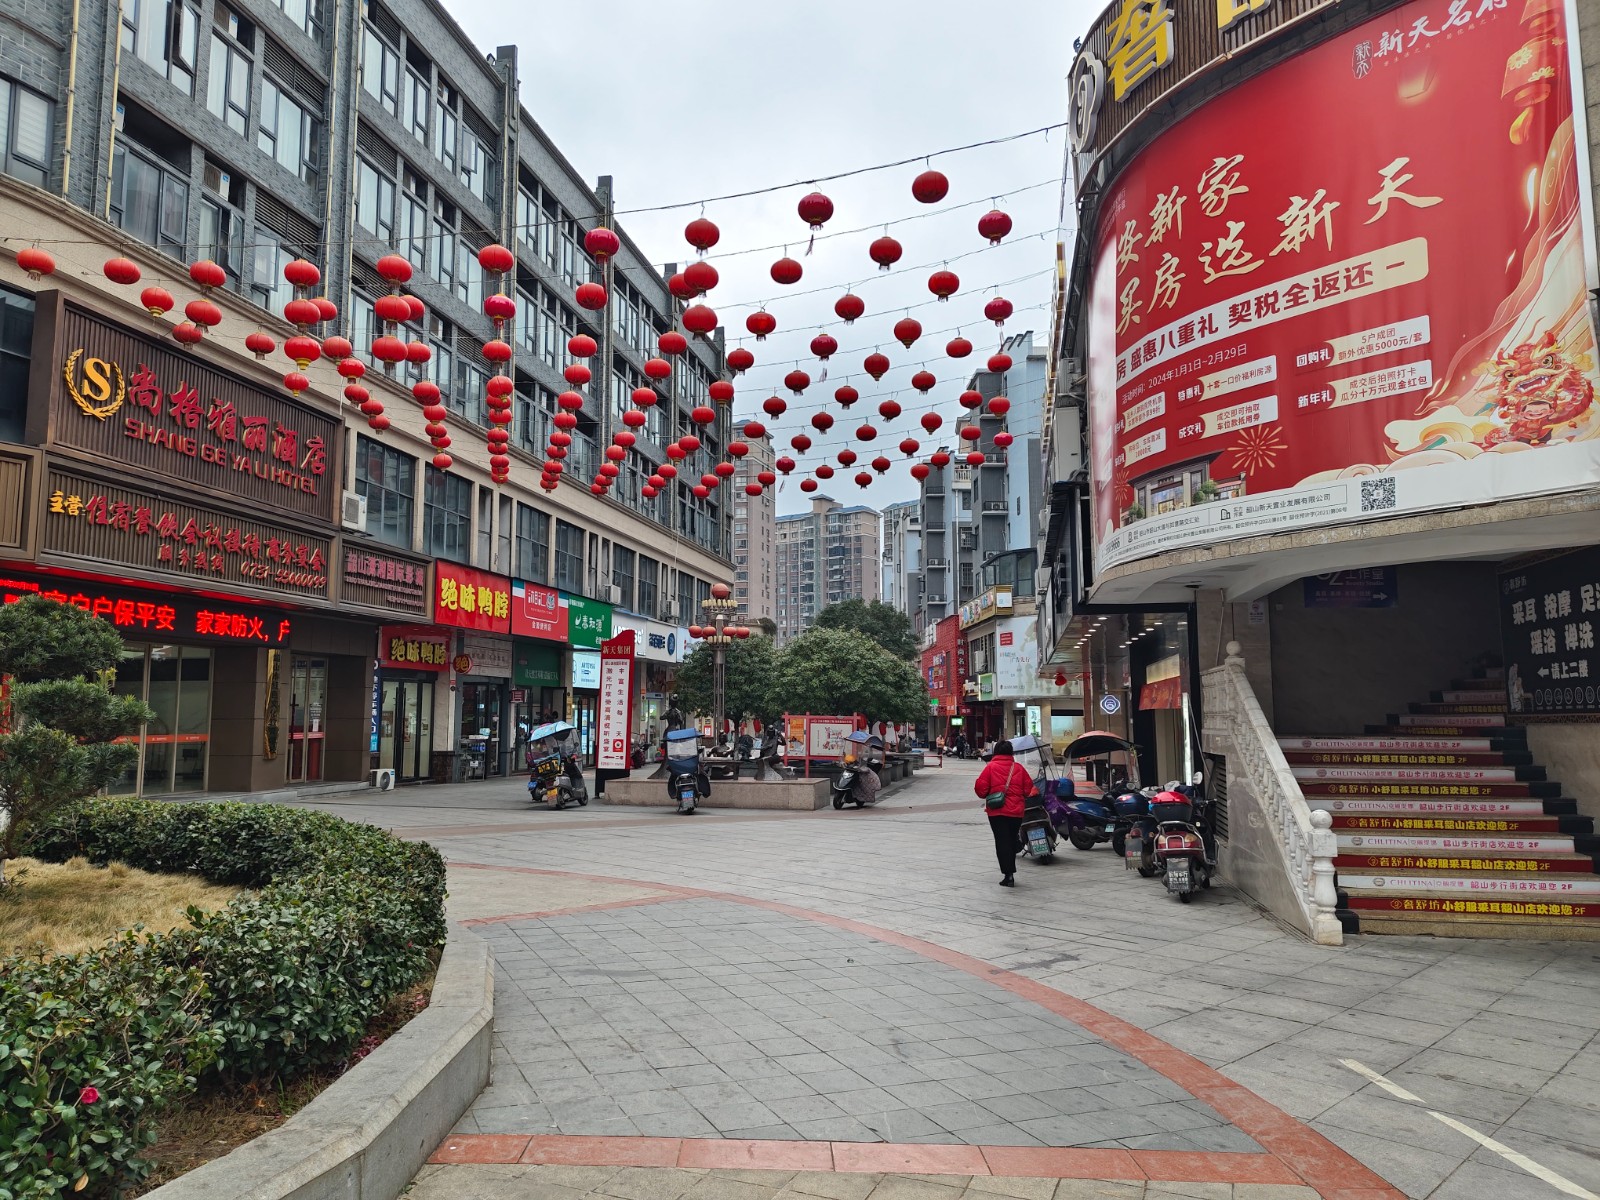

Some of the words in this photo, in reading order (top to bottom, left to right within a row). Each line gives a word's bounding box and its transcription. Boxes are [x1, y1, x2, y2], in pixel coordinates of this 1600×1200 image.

[1131, 313, 1218, 372] 盛惠八重礼
[1362, 328, 1396, 343] 5户成团
[1338, 332, 1423, 360] 额外优惠5000元/套
[1296, 348, 1331, 367] 团购礼
[82, 357, 112, 401] S
[1207, 365, 1272, 391] 十套一口价福利房源
[1349, 367, 1417, 389] 成交后拍照打卡
[1341, 376, 1427, 402] 瓜分十万元现金红包
[1297, 390, 1332, 408] 新年礼
[128, 362, 327, 475] 尚格雅丽酒店
[1216, 403, 1260, 422] 成交即可抽取
[1179, 422, 1203, 439] 成交礼
[1217, 415, 1260, 431] 车位款抵用券
[125, 417, 198, 457] SHANG
[201, 443, 226, 468] GE
[230, 452, 252, 475] YA
[254, 460, 268, 480] LI
[271, 465, 318, 495] HOTEL
[440, 577, 509, 619] 绝味鸭脖
[1512, 598, 1537, 625] 采耳
[1544, 590, 1572, 620] 按摩
[391, 638, 447, 664] 绝味鸭脖
[603, 645, 631, 655] 新天集团
[455, 656, 471, 673] 绝
[1551, 659, 1589, 680] 请上二楼
[616, 668, 625, 737] 丰富生活每一天
[1371, 785, 1479, 795] 小舒服采耳韶山店欢迎您
[1419, 803, 1497, 812] 韶山步行街店欢迎您
[1359, 818, 1391, 828] 奢舒坊
[1393, 818, 1508, 831] 小舒服采耳韶山店欢迎您
[1509, 823, 1520, 831] 2F
[1443, 840, 1524, 849] 韶山步行街店欢迎您
[1379, 856, 1414, 867] 奢舒坊
[1416, 858, 1538, 871] 小舒服采耳韶山店欢迎您
[1539, 862, 1551, 871] 2F
[1470, 880, 1557, 891] 韶山步行街店欢迎您
[1403, 900, 1440, 910] 奢舒坊
[1442, 901, 1573, 915] 小舒服采耳韶山店欢迎您
[1574, 907, 1586, 915] 2F
